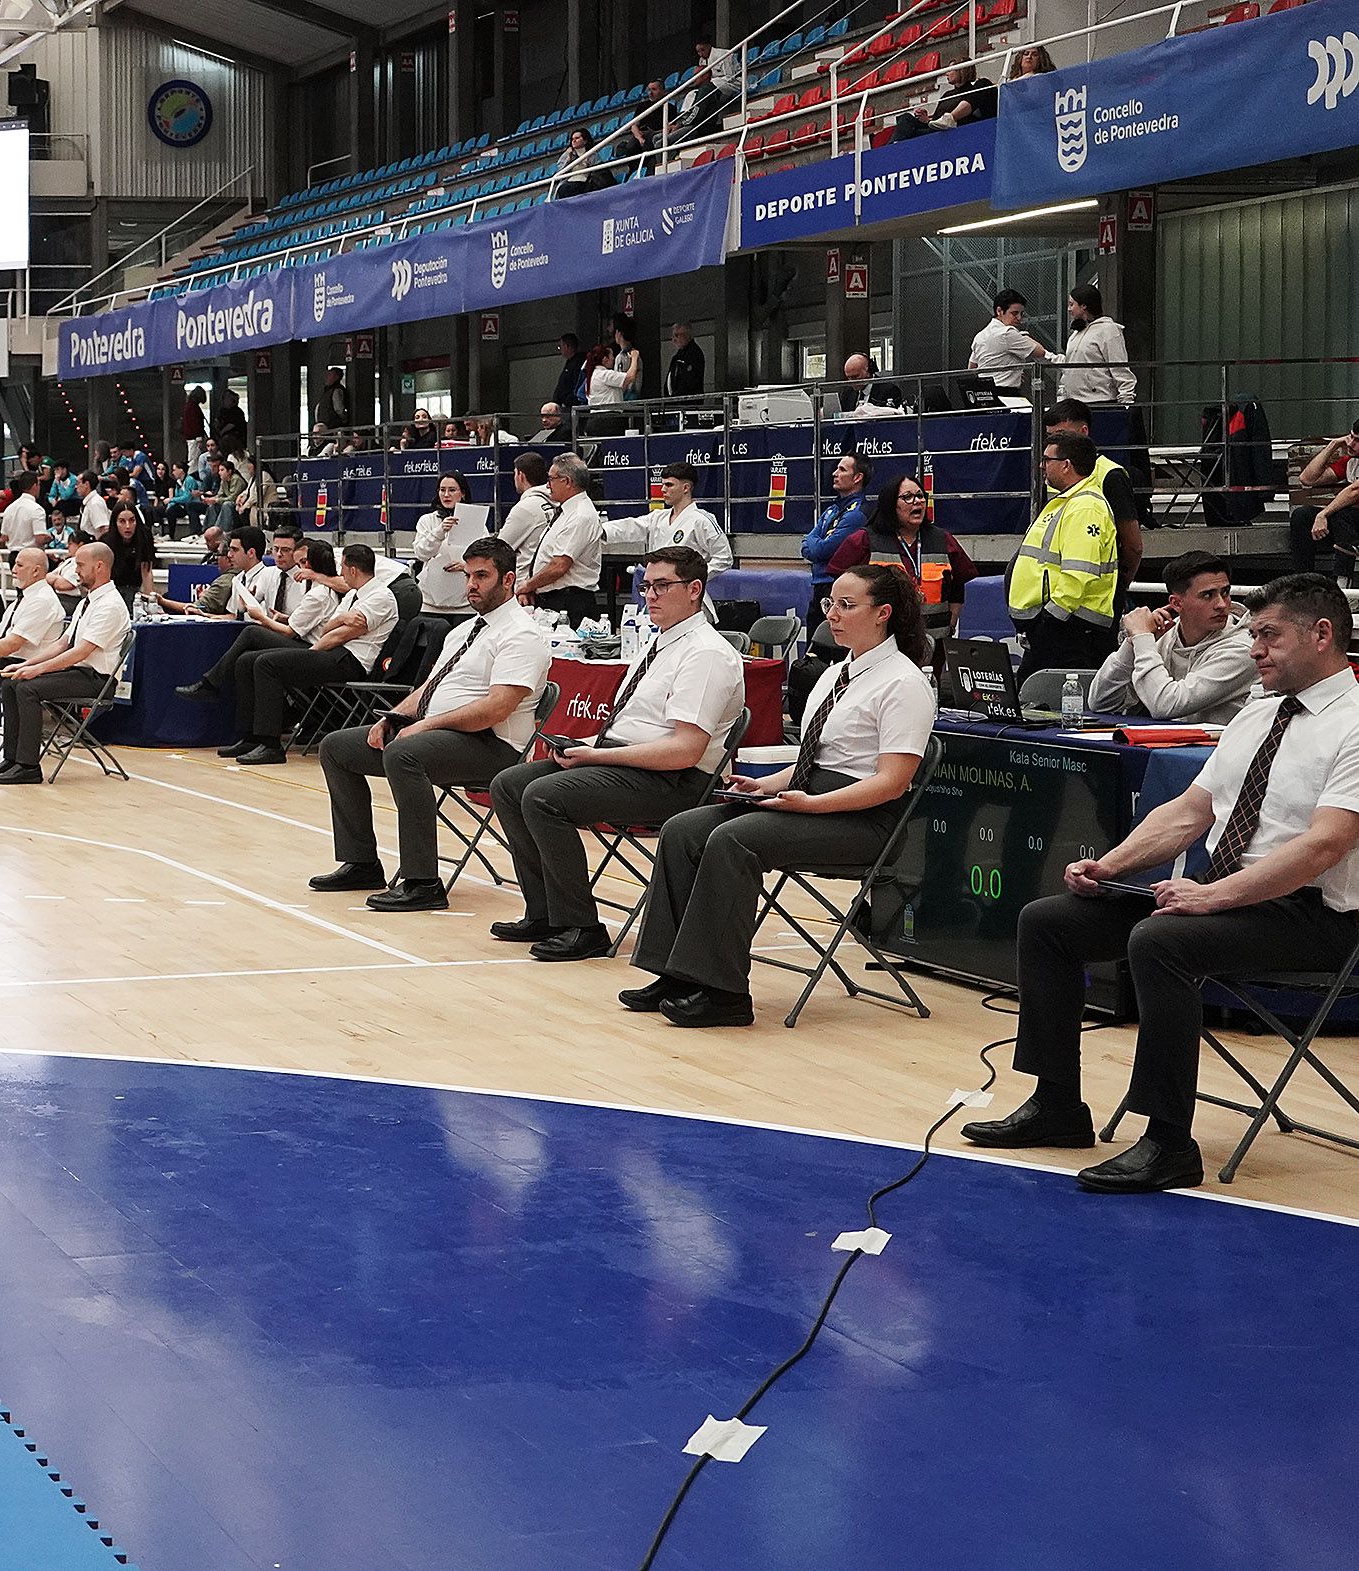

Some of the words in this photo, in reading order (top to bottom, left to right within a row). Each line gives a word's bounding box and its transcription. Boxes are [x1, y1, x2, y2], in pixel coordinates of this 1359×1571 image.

[1094, 98, 1143, 124] Concello
[1094, 128, 1109, 145] de
[1110, 113, 1179, 142] Pontevedra
[755, 187, 837, 222] DEPORTE
[844, 153, 986, 201] PONTEVEDRA
[672, 202, 695, 215] DEPORTE
[1132, 200, 1148, 220] A
[615, 215, 640, 234] XUNTA
[614, 235, 624, 248] DE
[625, 228, 655, 248] GALICIA
[1102, 224, 1114, 244] A
[510, 241, 534, 257] Concello
[414, 256, 448, 275] Deputación
[509, 260, 517, 272] de
[517, 252, 549, 270] Pontevedra
[829, 257, 837, 274] A
[414, 272, 448, 288] Pontevedra
[849, 272, 864, 288] A
[176, 290, 274, 350] Pontevedra
[484, 320, 496, 332] A
[70, 318, 145, 368] Pontevedra
[359, 340, 370, 352] A
[258, 357, 268, 367] A
[173, 370, 182, 378] A
[856, 438, 892, 454] rfek.es
[604, 451, 630, 466] rfek.es
[686, 448, 710, 464] rfek.e
[972, 671, 1004, 682] LOTERÍAS
[566, 692, 610, 720] rfek.es
[1010, 750, 1030, 765] Kata
[1032, 752, 1060, 769] Senior
[1062, 756, 1087, 772] Masc
[1020, 774, 1033, 792] A.
[934, 819, 946, 834] 0.0
[979, 827, 994, 842] 0.0
[1028, 836, 1042, 850] 0.0
[1080, 844, 1094, 860] 0.0
[970, 864, 1002, 900] 0.0
